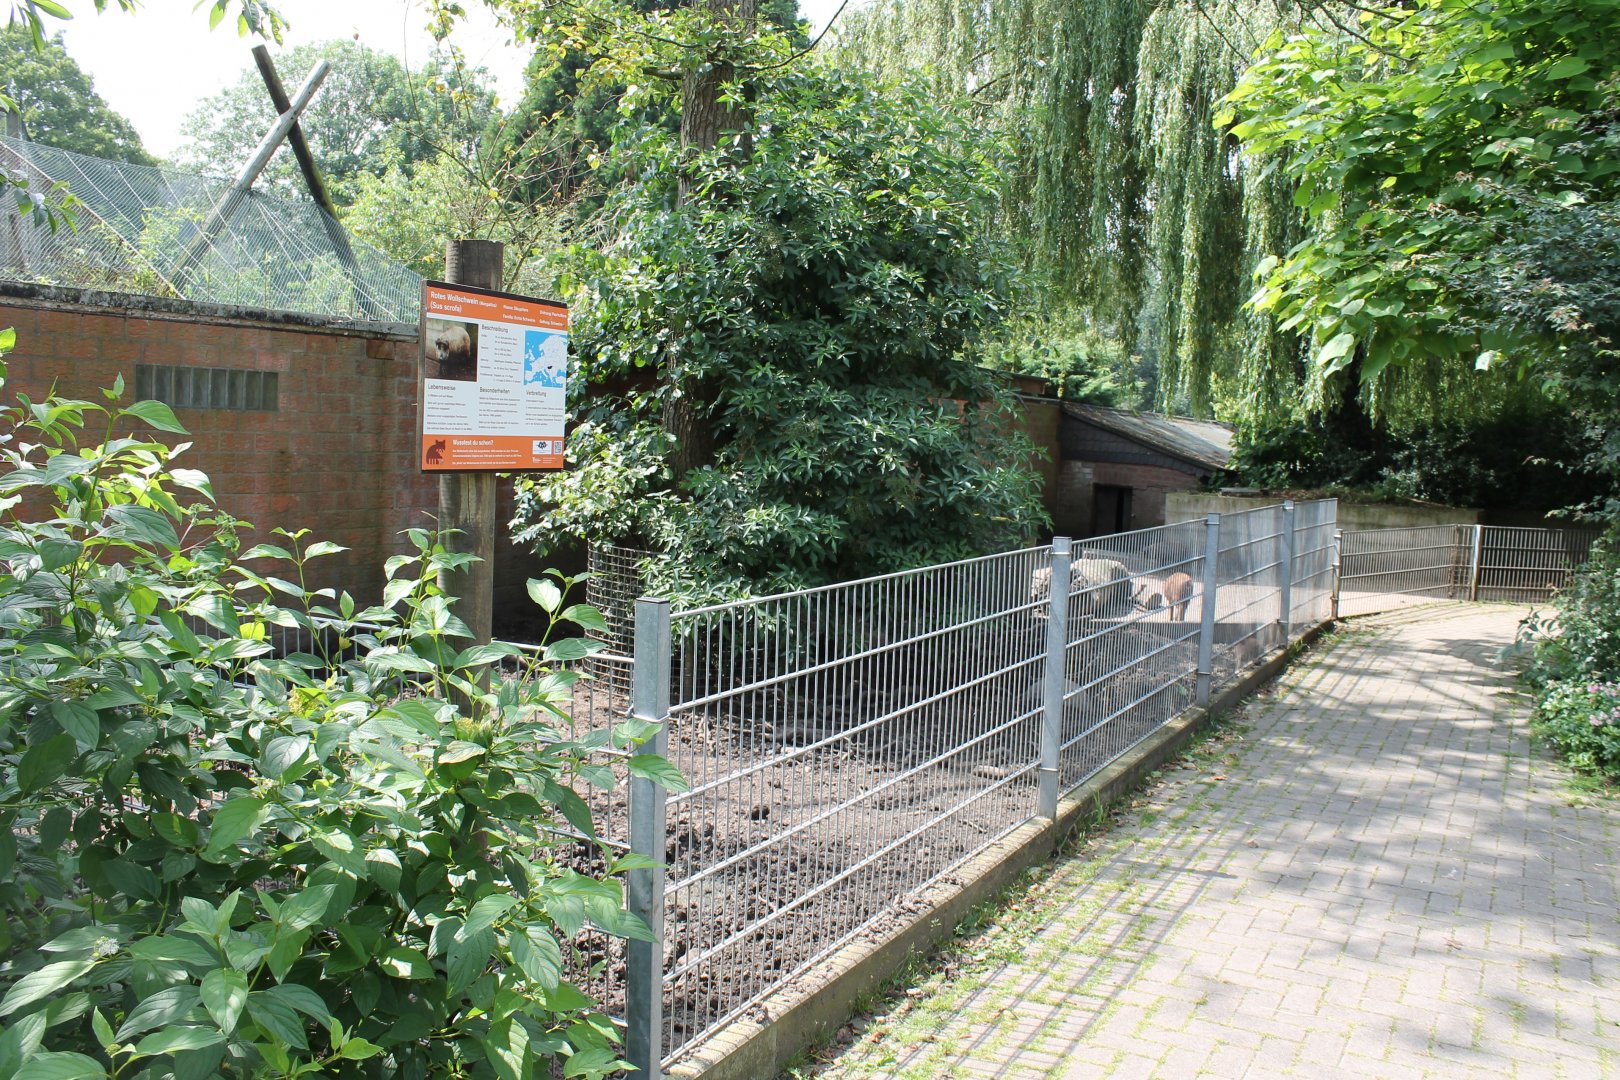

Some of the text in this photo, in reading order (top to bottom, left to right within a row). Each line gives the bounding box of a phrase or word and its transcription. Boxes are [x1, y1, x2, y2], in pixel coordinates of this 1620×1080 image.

[431, 291, 479, 305] Rotes Wollschwein
[431, 301, 462, 313] (Sus scrofa)
[482, 324, 509, 333] Beschreibung
[480, 386, 510, 394] Besonderheiten
[526, 390, 547, 398] Verbreitung
